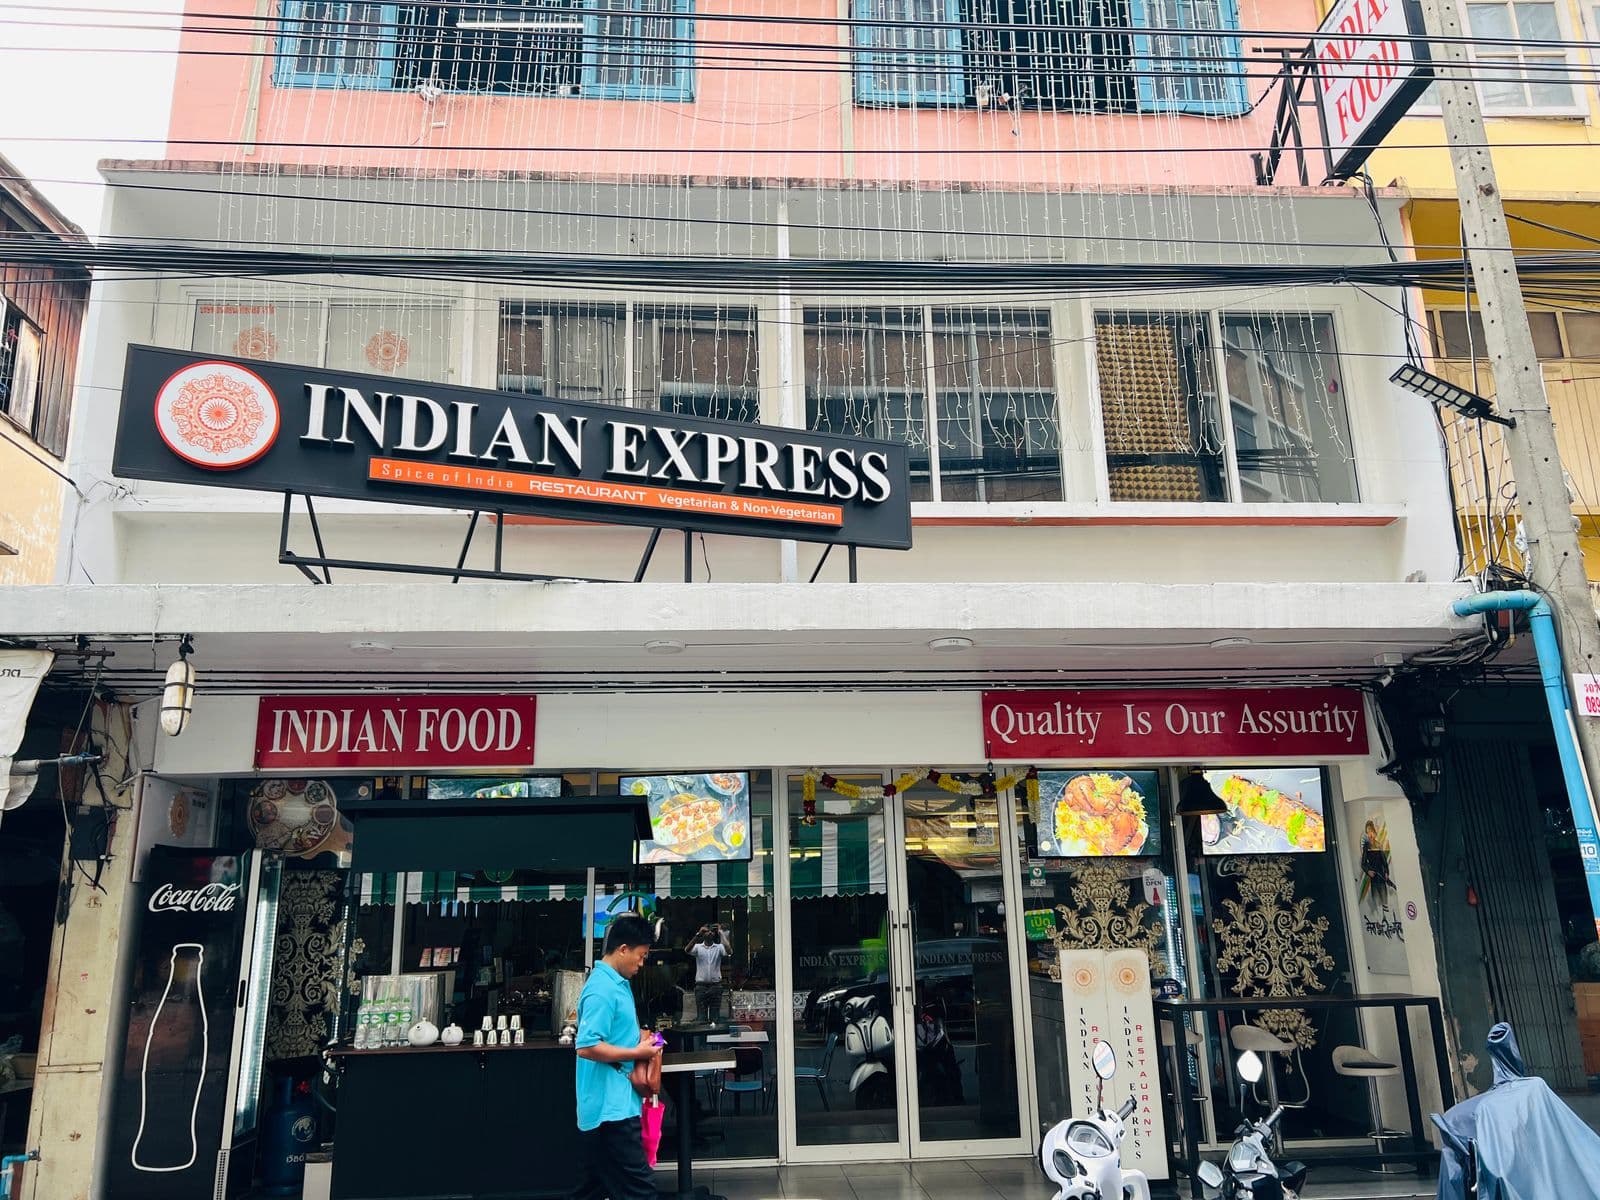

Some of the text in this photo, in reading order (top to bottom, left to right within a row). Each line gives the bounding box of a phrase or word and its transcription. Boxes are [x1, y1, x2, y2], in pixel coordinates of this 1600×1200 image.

[1319, 0, 1389, 94] INDIA
[1335, 38, 1399, 143] FOOD
[300, 382, 892, 503] INDIAN EXPRESS
[382, 462, 836, 521] Spice of India RESTAURANT Vegetarian & Non-Vegetarian
[269, 708, 522, 753] INDIAN FOOD
[990, 701, 1359, 744] Quality Is Our Assurity
[1583, 846, 1595, 856] 10
[148, 883, 242, 912] Coca-Cola
[799, 951, 888, 967] INDIAN EXPRESS
[919, 951, 1004, 964] INDIAN EXPRESS
[1080, 1007, 1090, 1071] INDIAN
[1123, 1006, 1134, 1069] INDIAN
[1135, 1025, 1151, 1137] RESTAURANT
